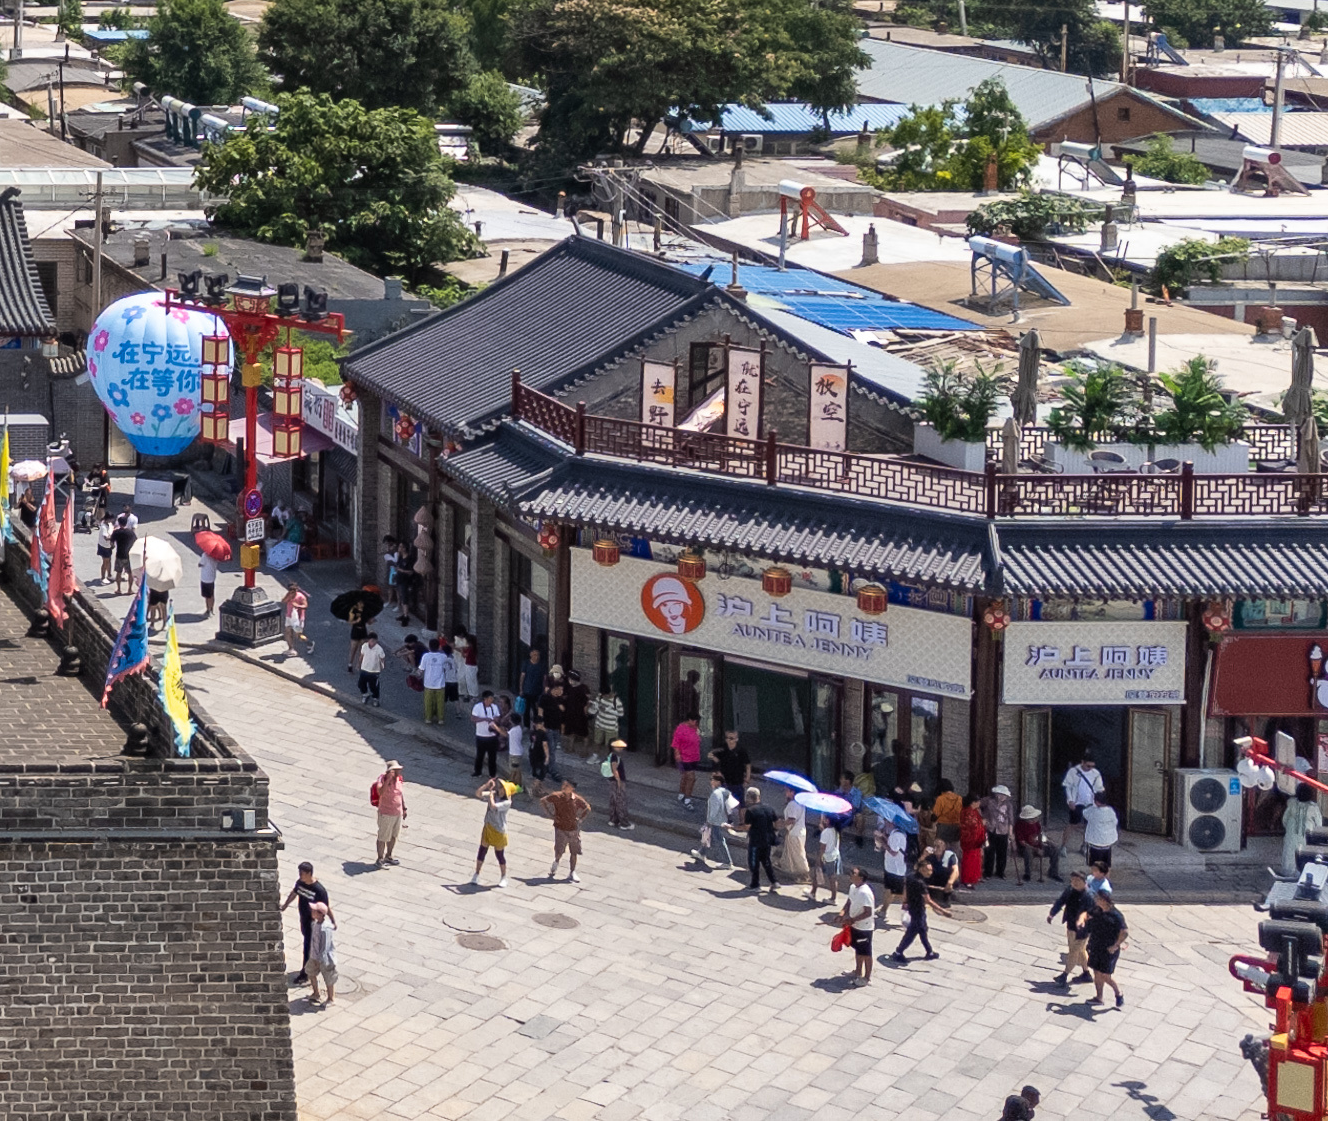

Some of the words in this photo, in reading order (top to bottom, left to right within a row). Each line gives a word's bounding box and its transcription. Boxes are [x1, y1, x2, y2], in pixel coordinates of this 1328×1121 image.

[112, 340, 202, 368] 在宁远
[121, 367, 200, 397] 在等你
[815, 377, 844, 422] 放空
[716, 593, 888, 647] 沪上阿姨
[732, 623, 806, 648] AUNTEA
[811, 637, 873, 660] JENNY
[1025, 645, 1168, 666] 沪上阿姨
[1039, 668, 1099, 679] AUNTEA
[1105, 668, 1156, 679] JENNY
